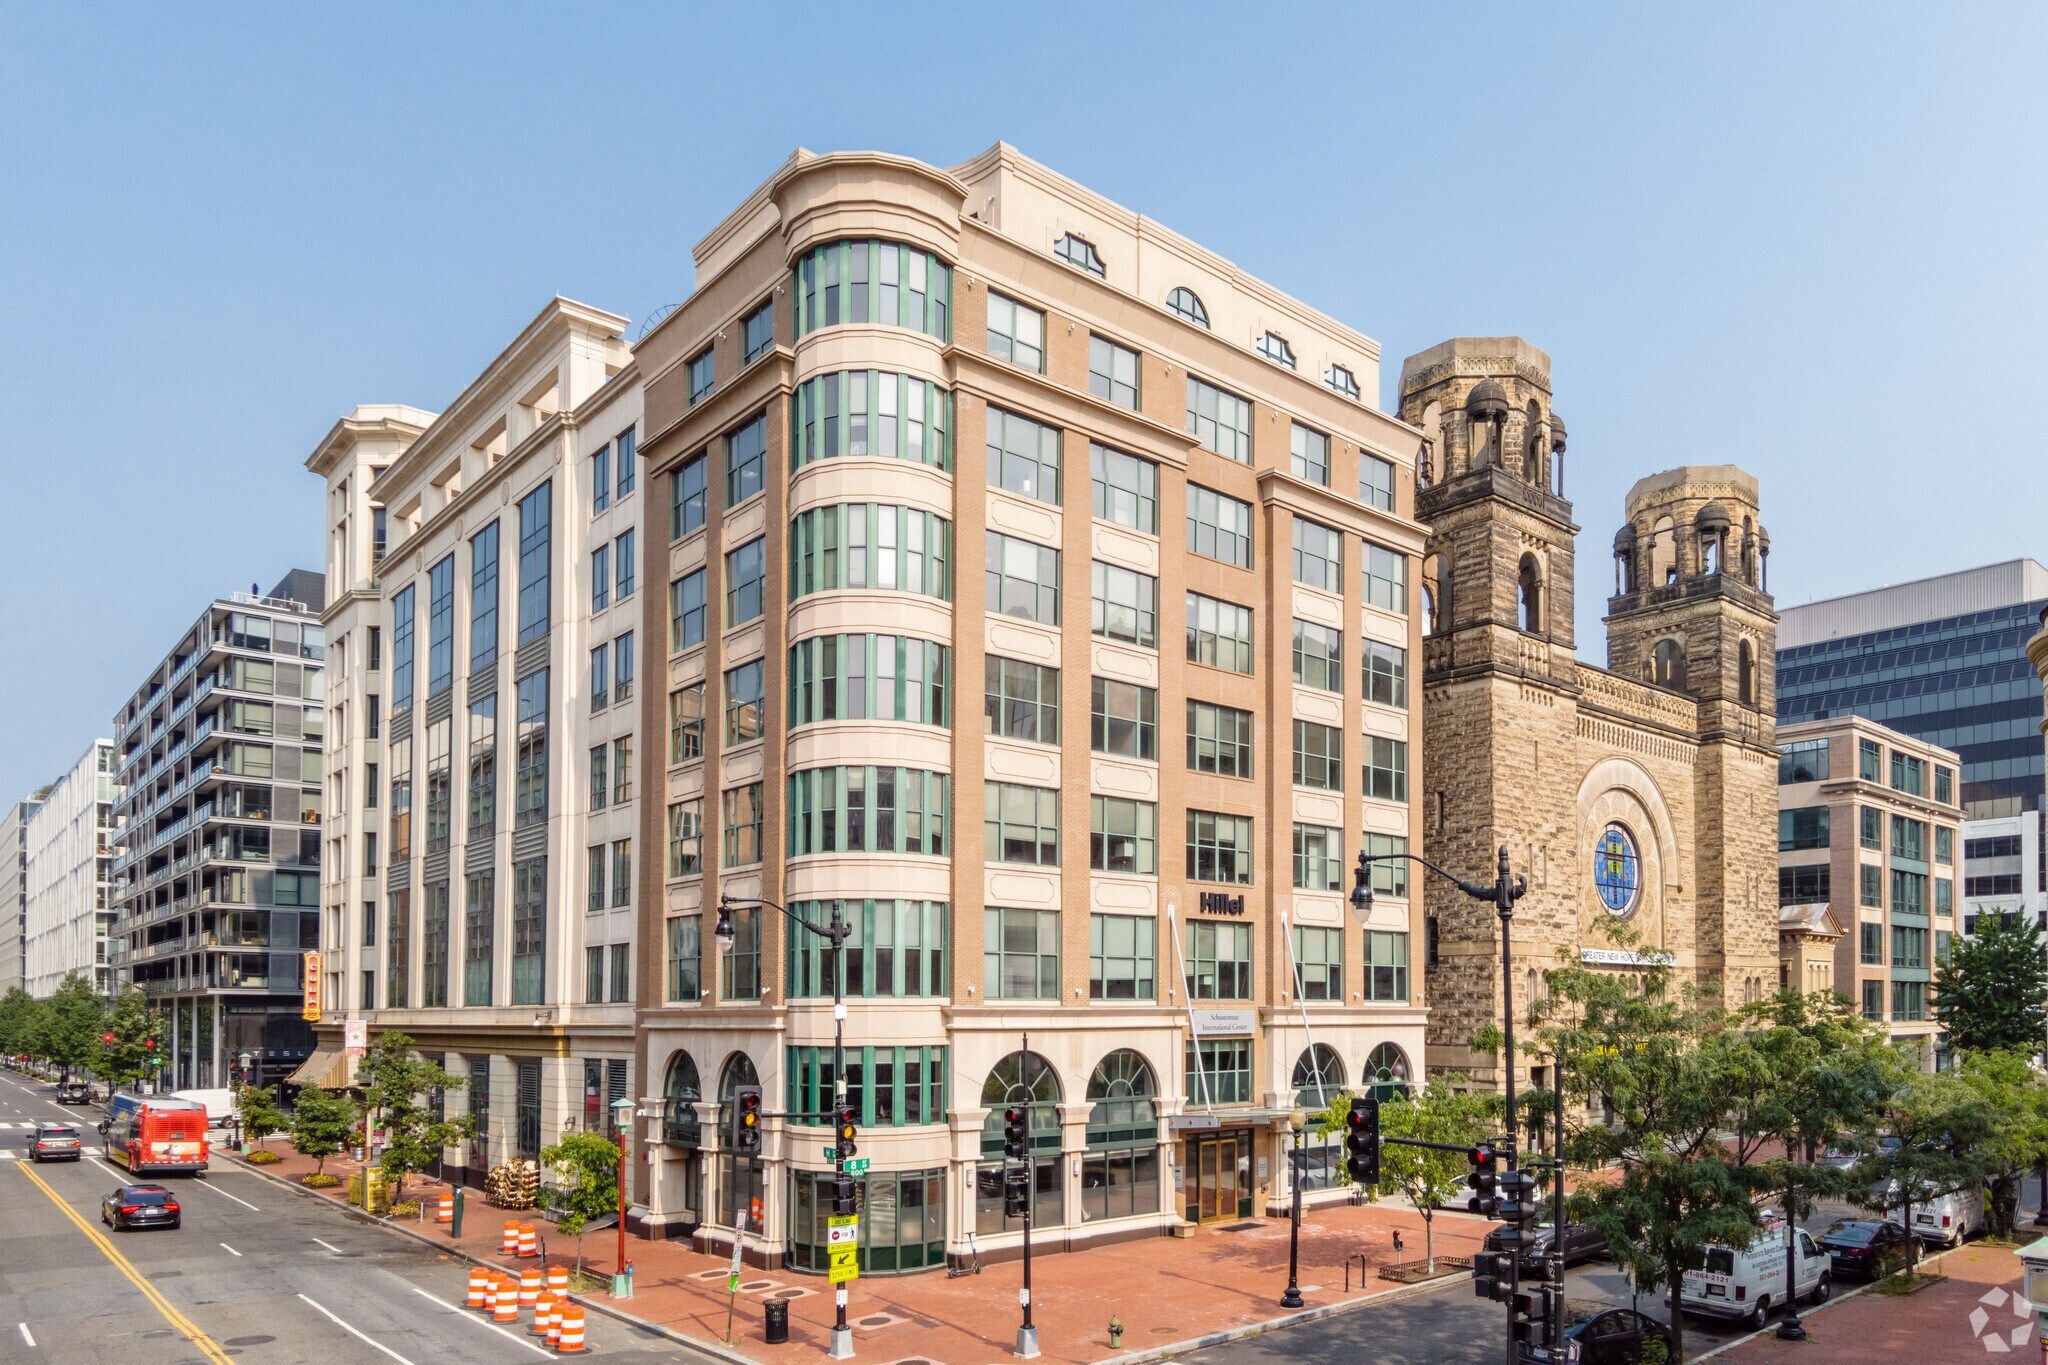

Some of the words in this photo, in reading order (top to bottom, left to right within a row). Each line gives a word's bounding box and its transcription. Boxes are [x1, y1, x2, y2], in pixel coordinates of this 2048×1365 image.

[1200, 892, 1245, 915] Hillel
[1607, 953, 1619, 961] NEW
[309, 964, 317, 1004] CUBA
[1210, 1013, 1240, 1021] Schusterman
[1202, 1023, 1231, 1031] International
[1232, 1022, 1248, 1030] Center
[851, 1161, 857, 1170] 8
[1684, 1270, 1729, 1283] 01-864-2121
